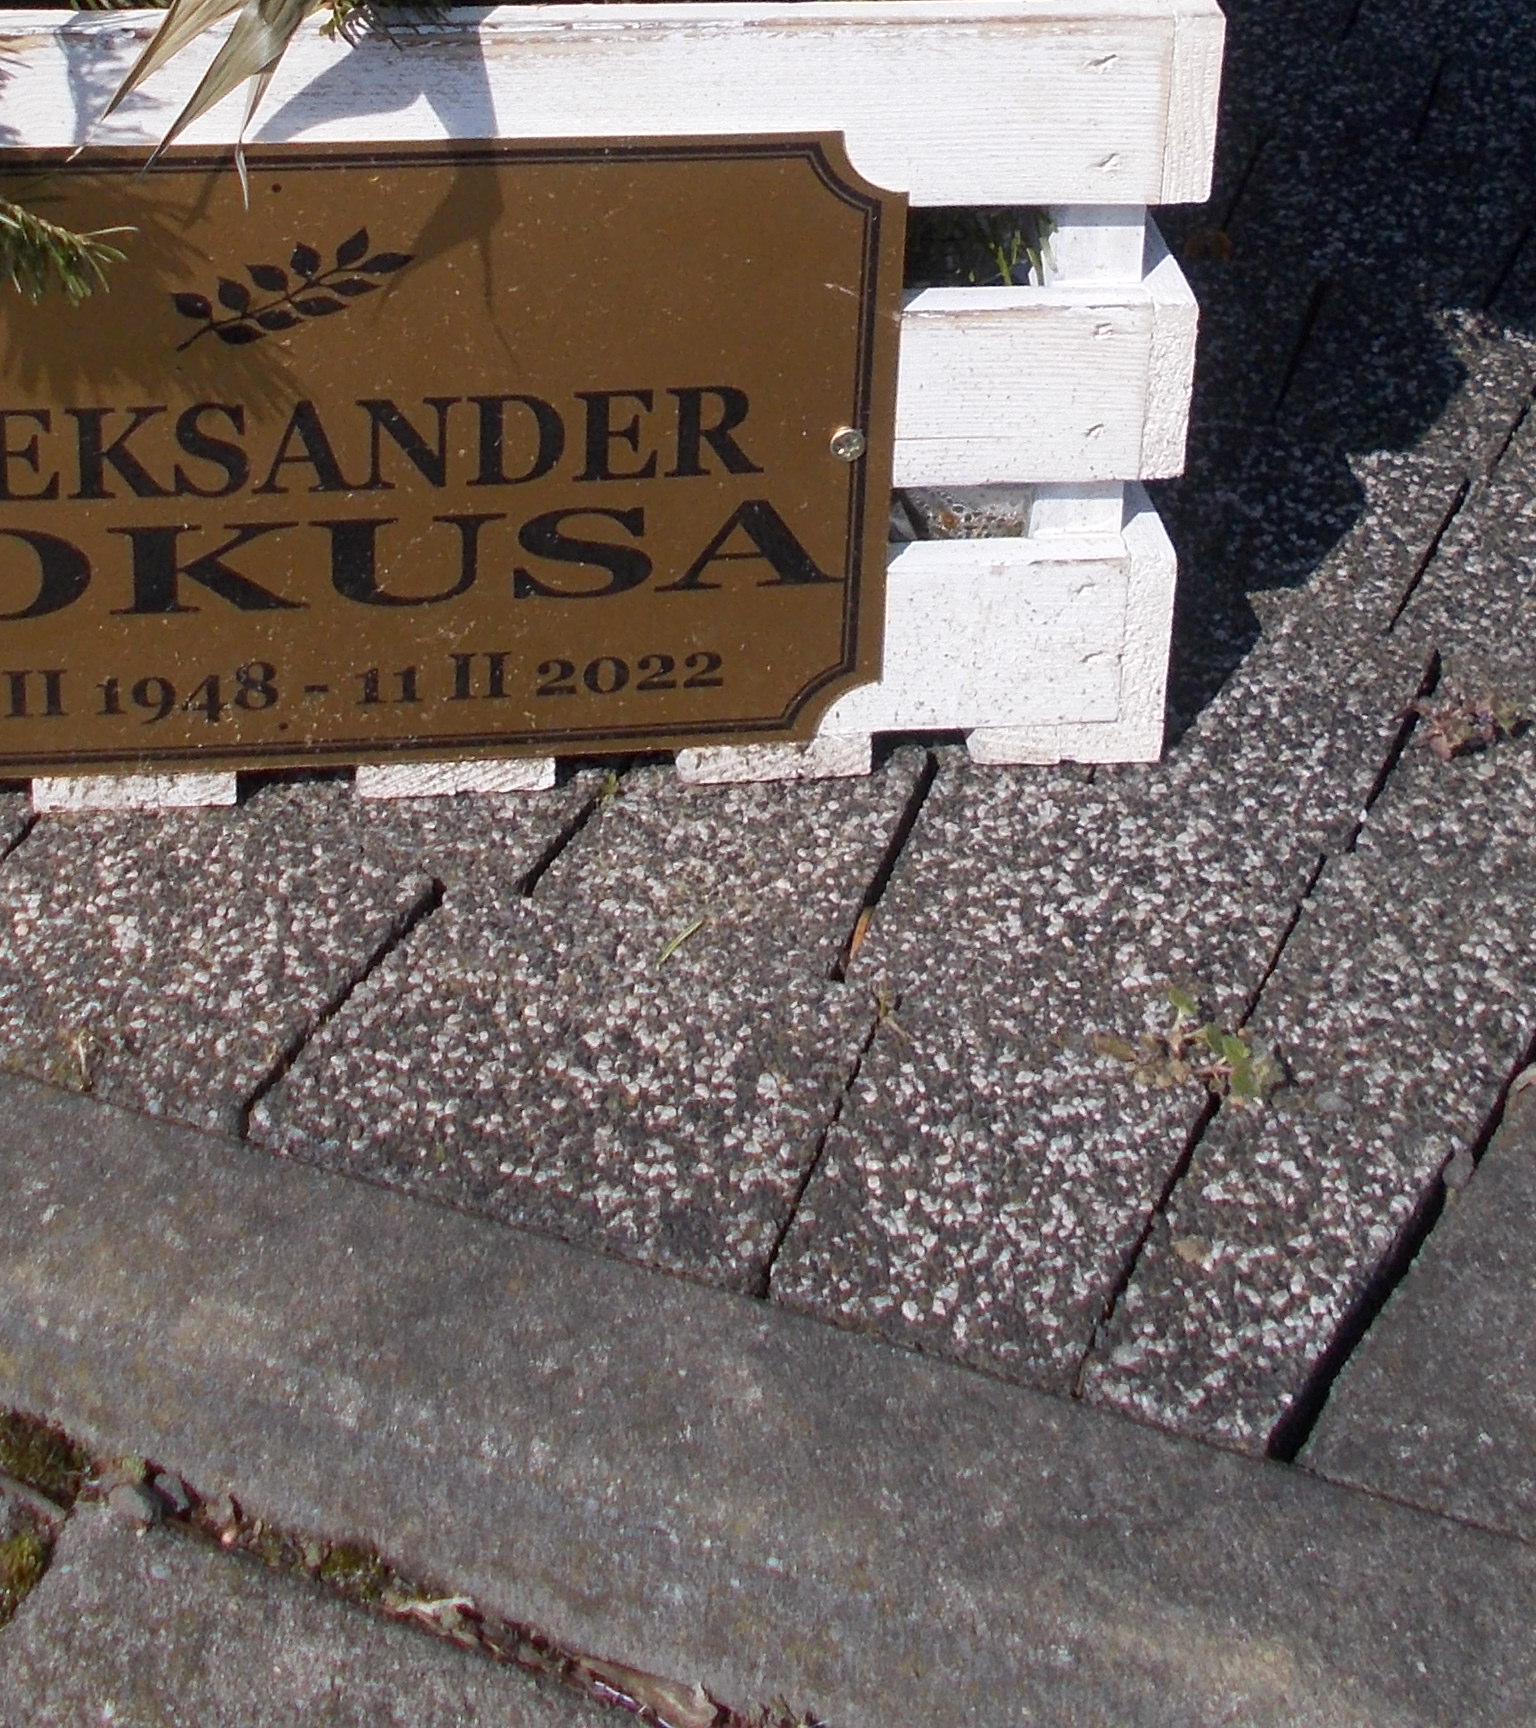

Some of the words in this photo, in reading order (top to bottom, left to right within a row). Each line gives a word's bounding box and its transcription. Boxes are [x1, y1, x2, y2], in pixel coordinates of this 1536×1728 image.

[96, 662, 278, 726] 1948
[354, 666, 424, 707] 11
[448, 651, 508, 701] II
[537, 650, 725, 697] 2022
